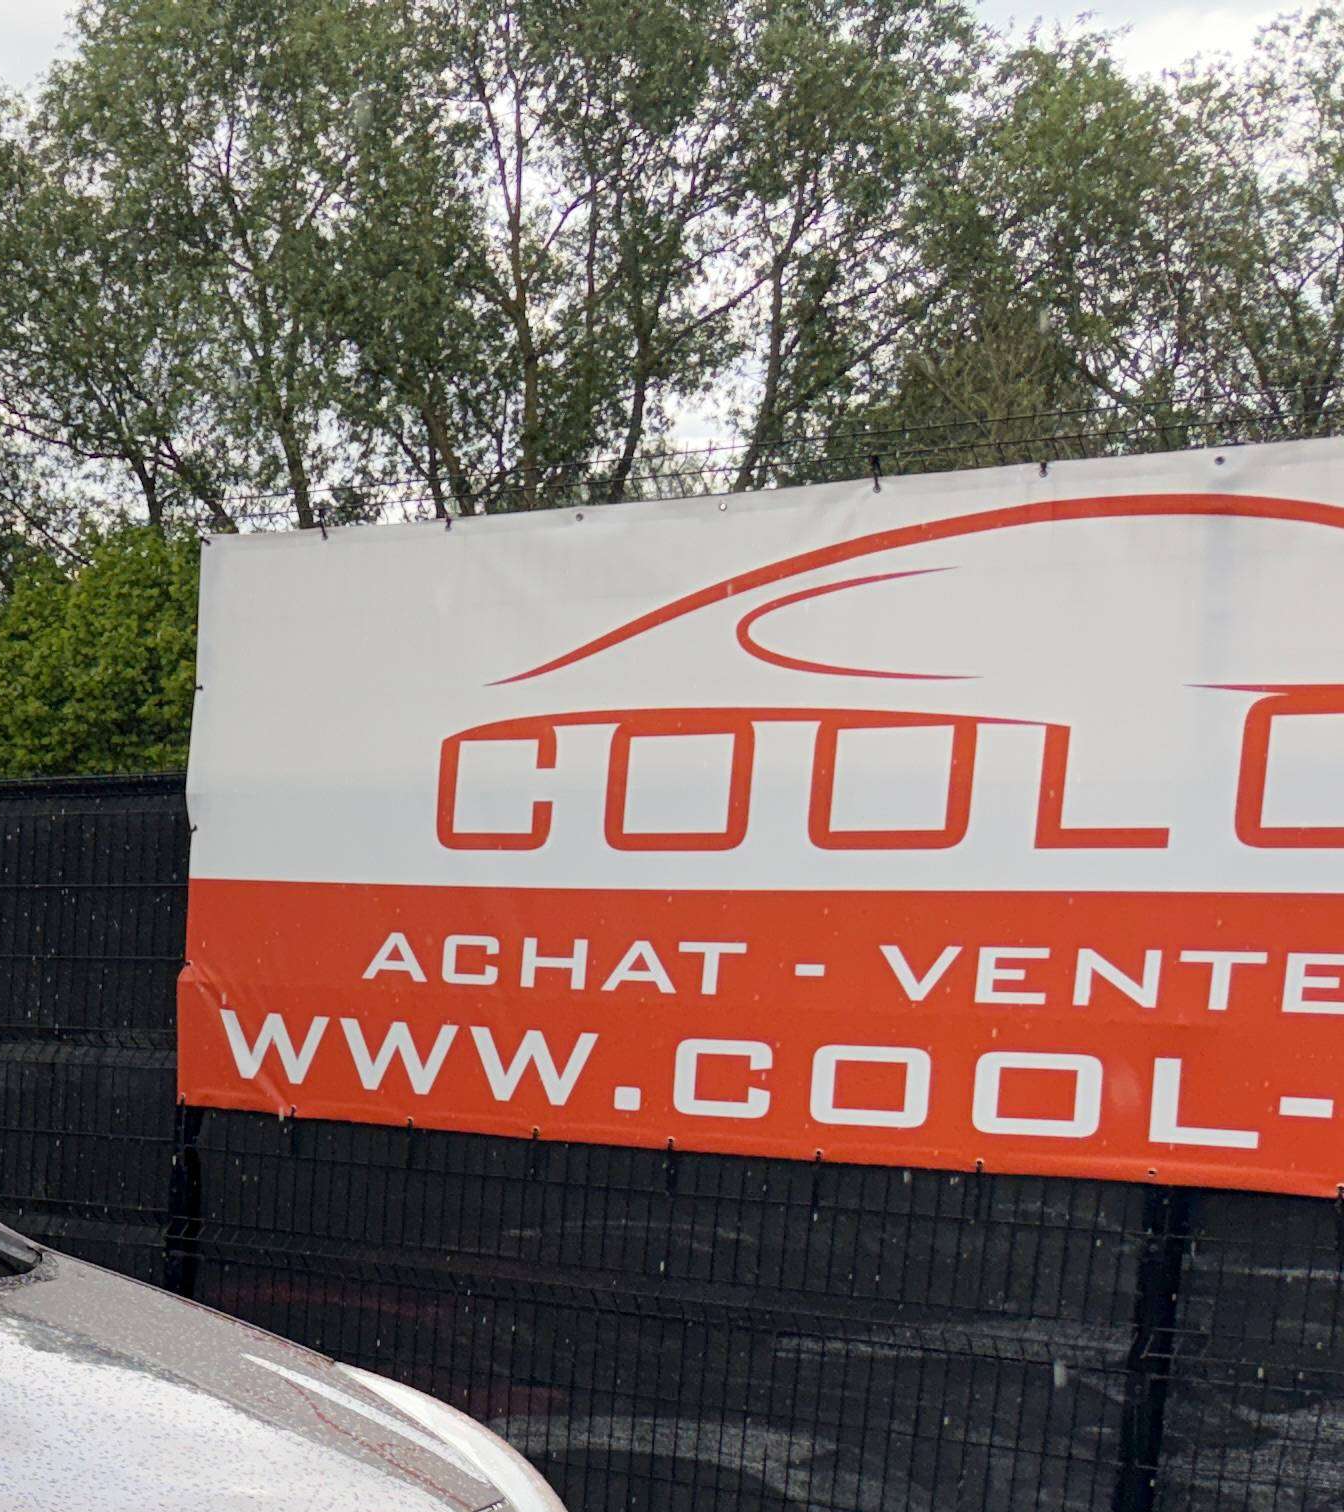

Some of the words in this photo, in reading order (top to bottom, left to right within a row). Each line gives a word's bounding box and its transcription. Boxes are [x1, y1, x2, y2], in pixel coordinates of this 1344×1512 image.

[437, 707, 1170, 851] COOL
[362, 932, 747, 995] ACHAT
[880, 945, 1344, 1015] VENTE
